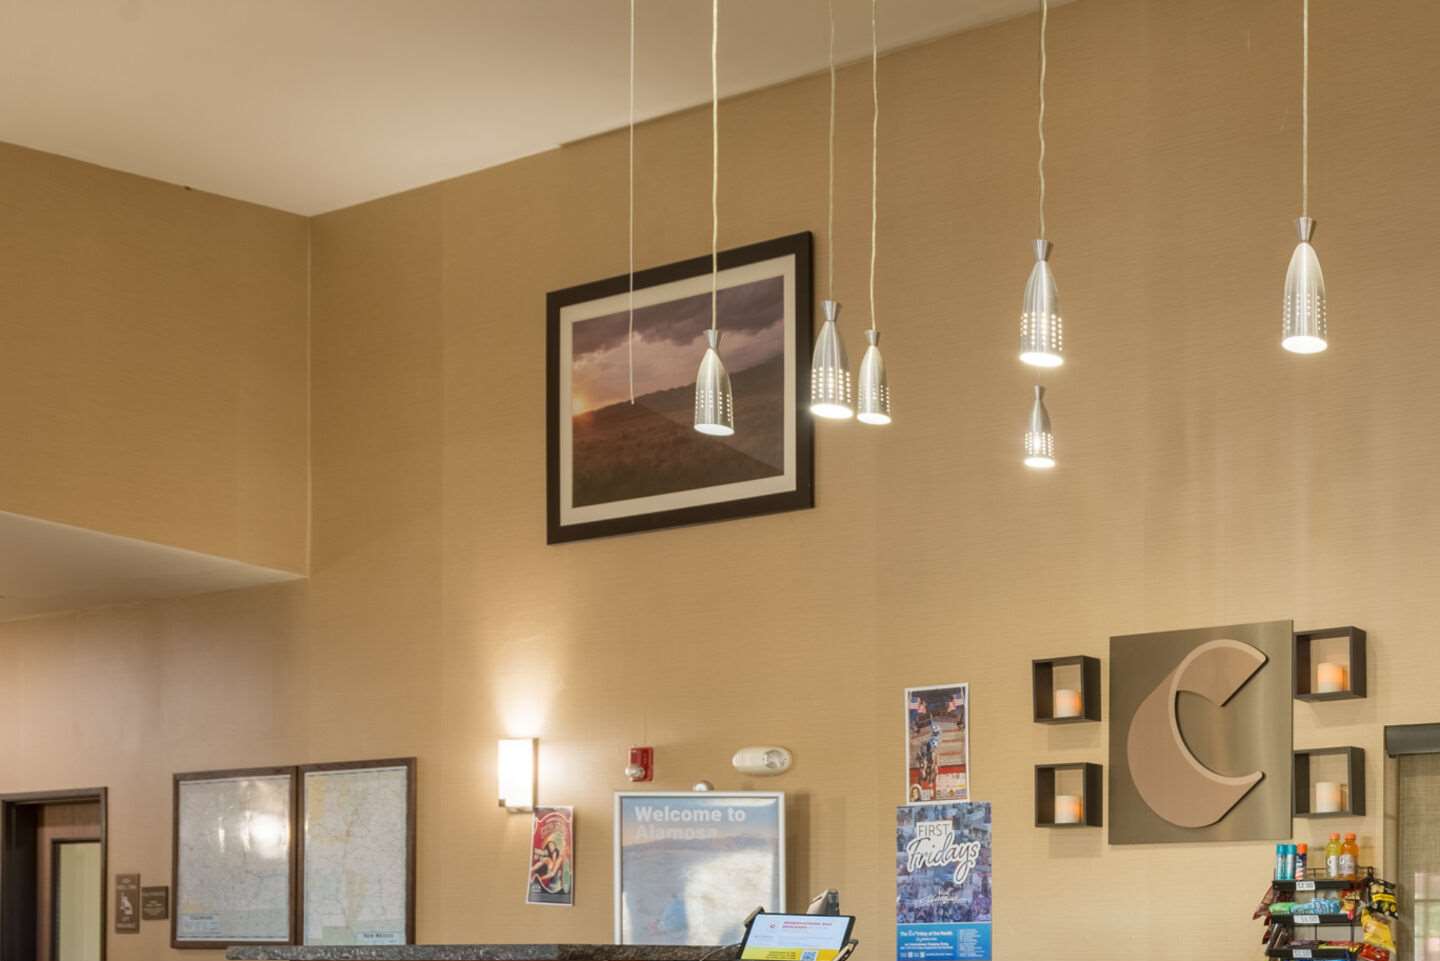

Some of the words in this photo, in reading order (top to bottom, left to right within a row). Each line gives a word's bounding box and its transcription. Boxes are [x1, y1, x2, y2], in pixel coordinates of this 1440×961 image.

[634, 806, 722, 822] Welcome
[727, 807, 746, 822] to
[918, 823, 949, 837] FIRST
[908, 832, 979, 882] Fridays
